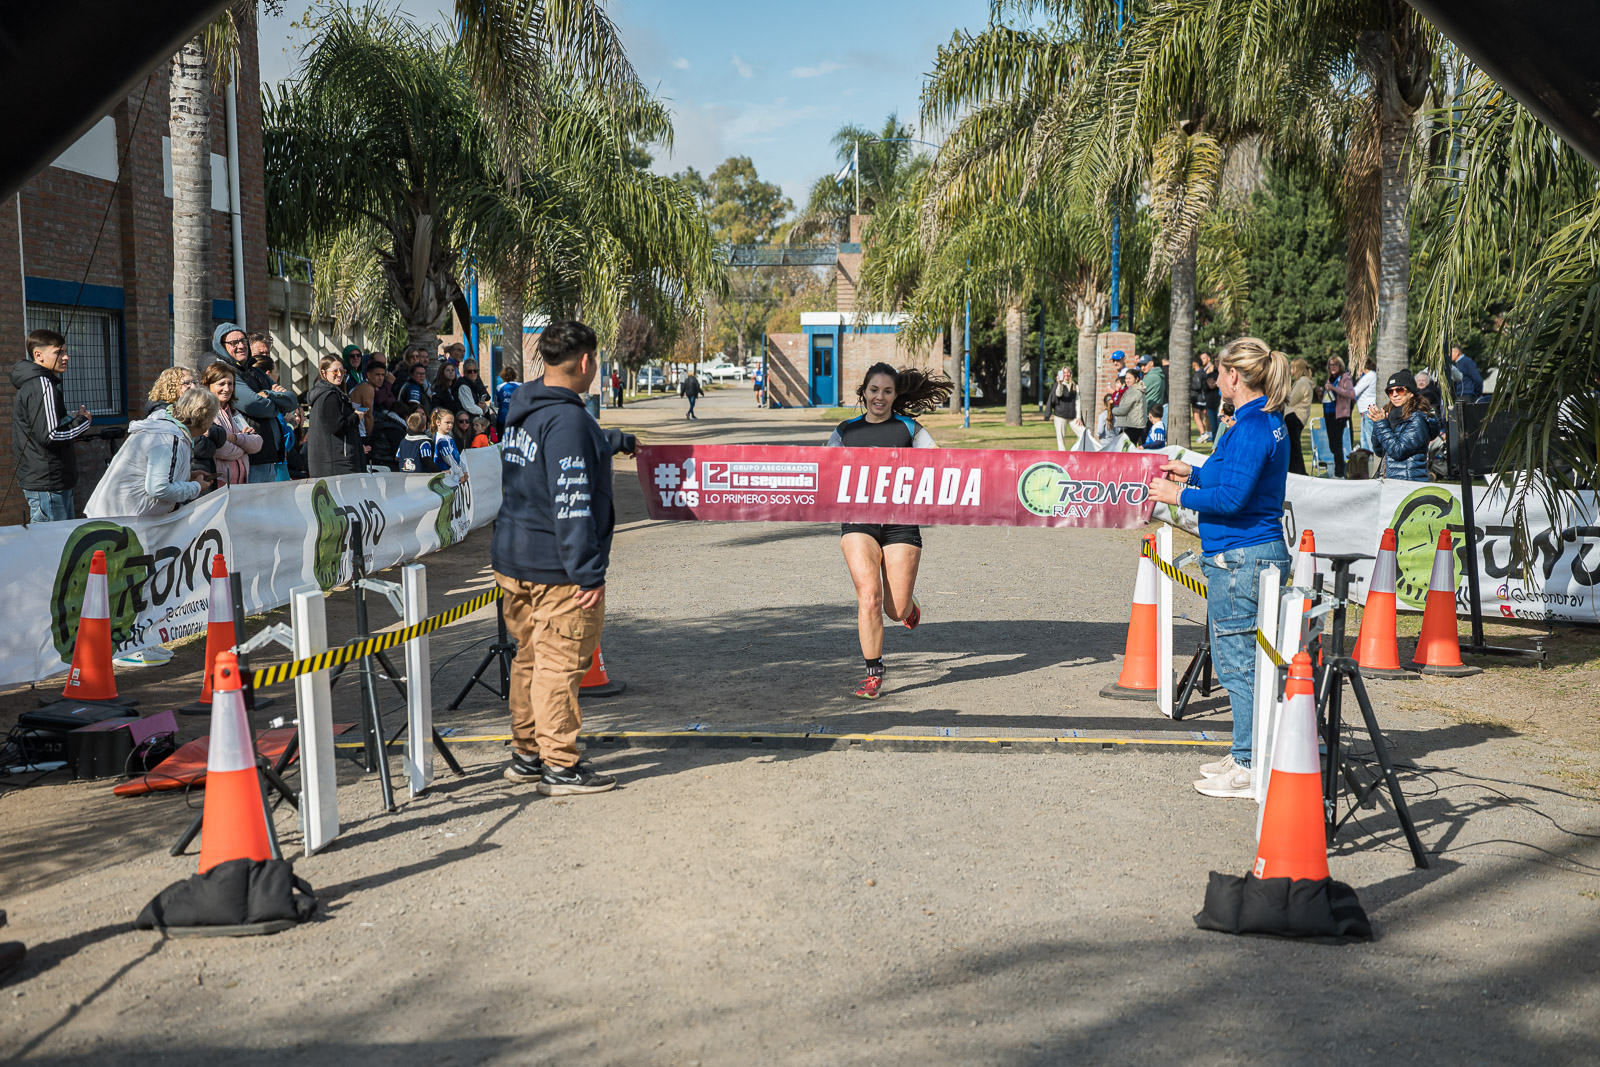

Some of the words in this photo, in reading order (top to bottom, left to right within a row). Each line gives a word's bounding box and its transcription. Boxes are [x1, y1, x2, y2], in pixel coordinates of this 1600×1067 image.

[654, 457, 699, 490] #1
[732, 464, 759, 472] GRUPO
[761, 464, 814, 472] ASEGURADOR
[750, 474, 814, 488] segunda
[836, 465, 982, 506] LLEGADA
[659, 490, 699, 507] VOS
[705, 493, 720, 504] LO
[722, 493, 767, 505] PRIMERO
[770, 494, 791, 505] SOS
[793, 494, 815, 505] VOS
[1053, 504, 1092, 518] RAV
[1511, 587, 1584, 608] @cronorav
